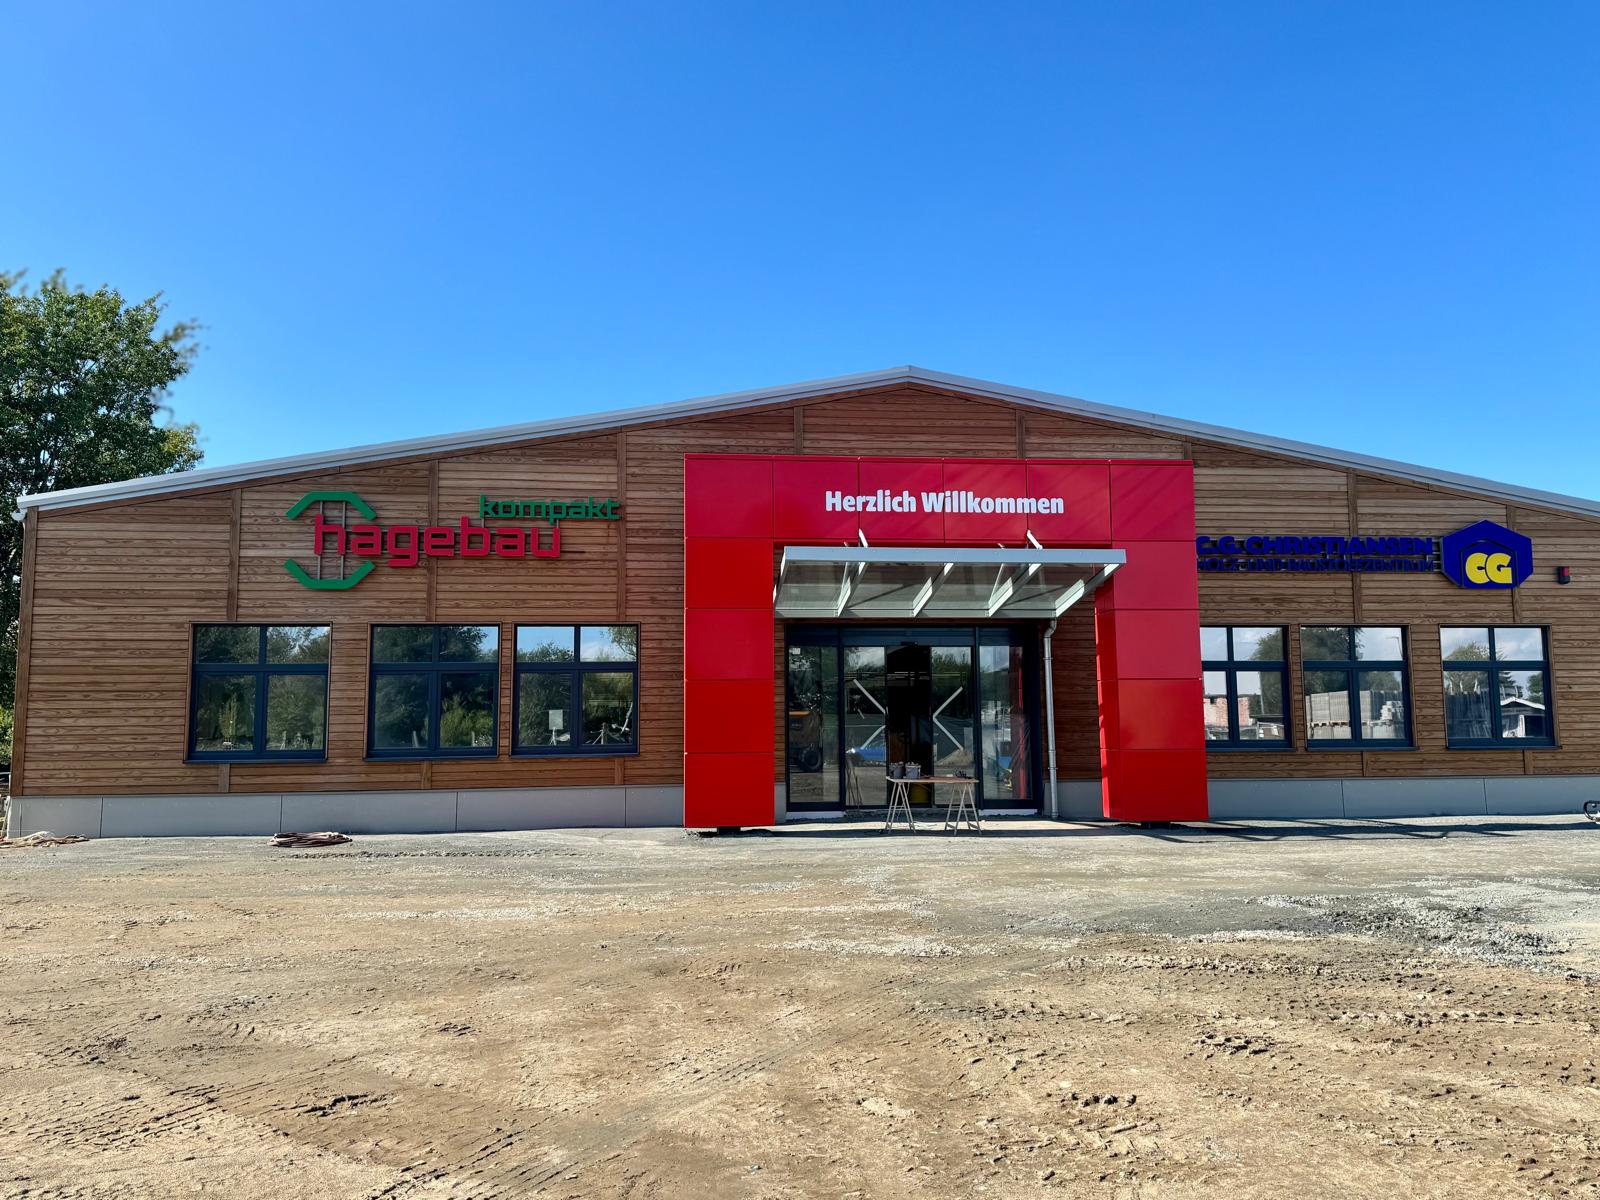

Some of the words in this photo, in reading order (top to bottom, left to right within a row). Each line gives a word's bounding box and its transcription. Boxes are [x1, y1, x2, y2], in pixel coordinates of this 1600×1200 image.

[479, 494, 621, 524] kompakt
[825, 489, 917, 513] Herzlich
[921, 490, 1065, 515] Willkommen
[314, 513, 561, 568] hagebau
[1465, 552, 1513, 584] CG
